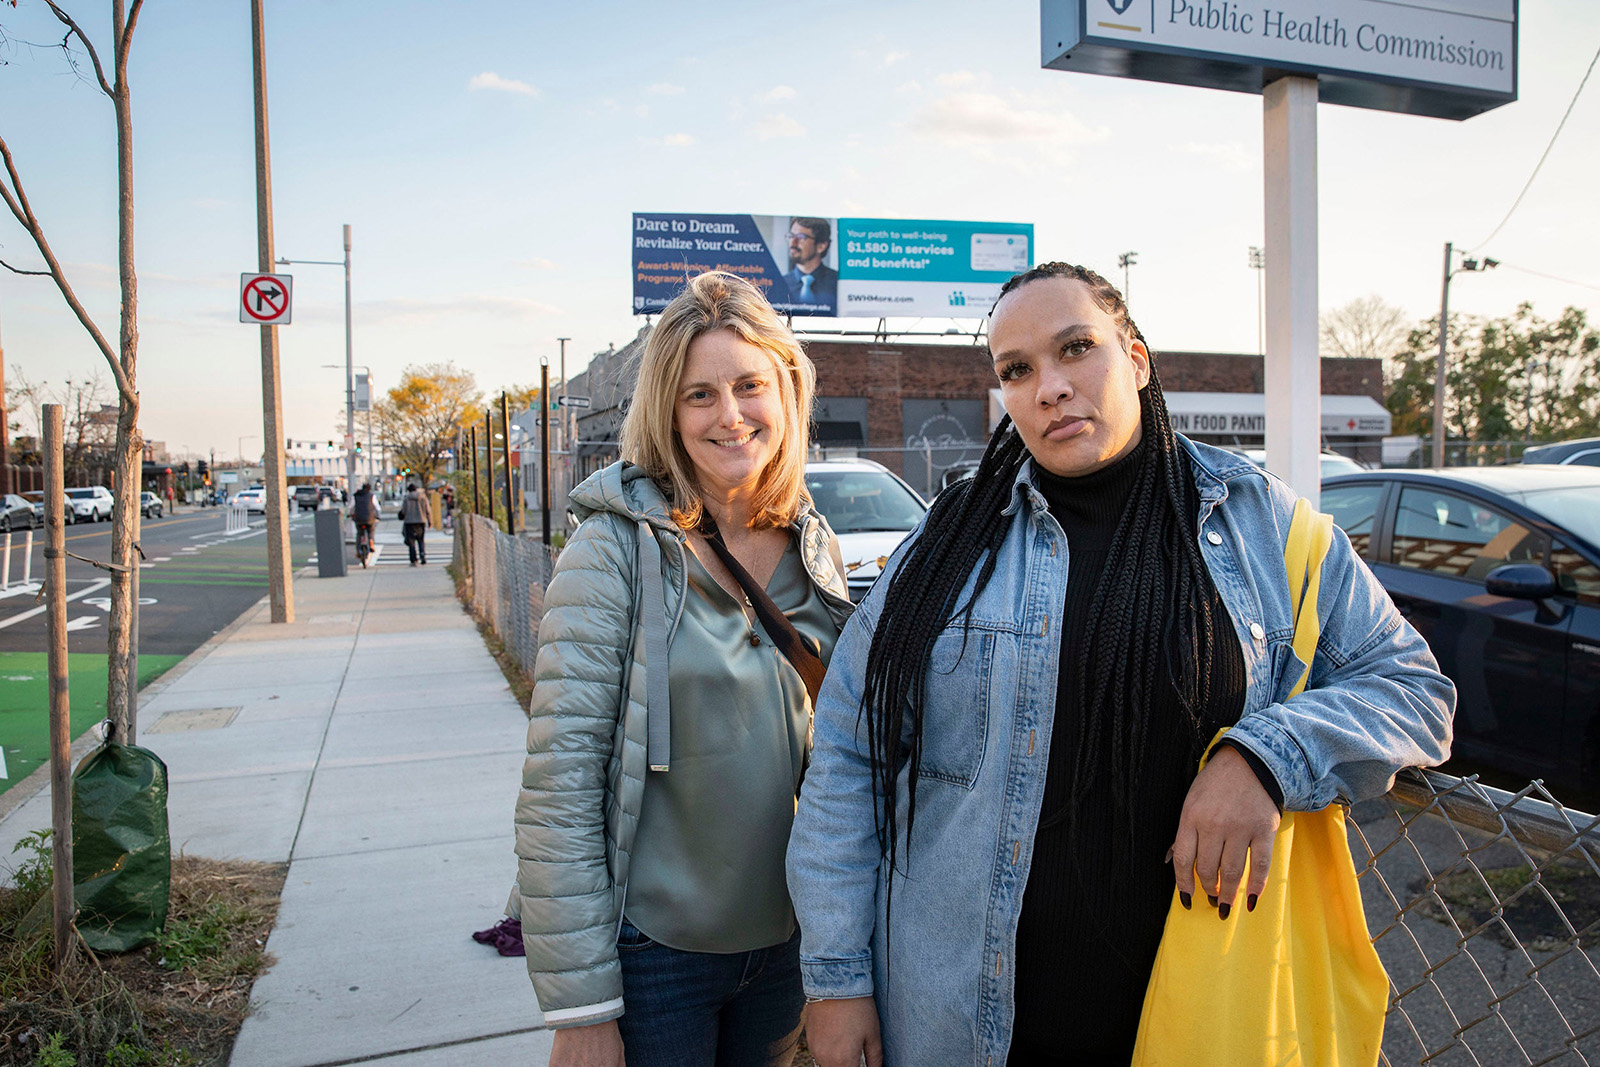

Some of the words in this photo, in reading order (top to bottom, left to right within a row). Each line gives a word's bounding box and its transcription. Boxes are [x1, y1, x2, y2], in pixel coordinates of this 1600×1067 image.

[1168, 0, 1254, 34] Public
[1261, 9, 1349, 48] Health
[1356, 23, 1505, 71] Commission
[635, 217, 670, 232] Dare
[672, 219, 687, 232] to
[688, 219, 740, 235] Dream.
[846, 229, 866, 238] Your
[867, 230, 889, 240] path
[890, 230, 900, 239] to
[901, 231, 948, 243] well-being
[635, 236, 693, 251] Revitalize
[694, 239, 722, 252] Your
[723, 240, 765, 254] Career.
[846, 240, 889, 254] $1,580
[891, 242, 903, 254] in
[904, 243, 955, 256] services
[846, 256, 870, 268] and
[1170, 415, 1189, 430] ON
[1193, 415, 1226, 431] FOOD
[1231, 415, 1265, 431] PANT
